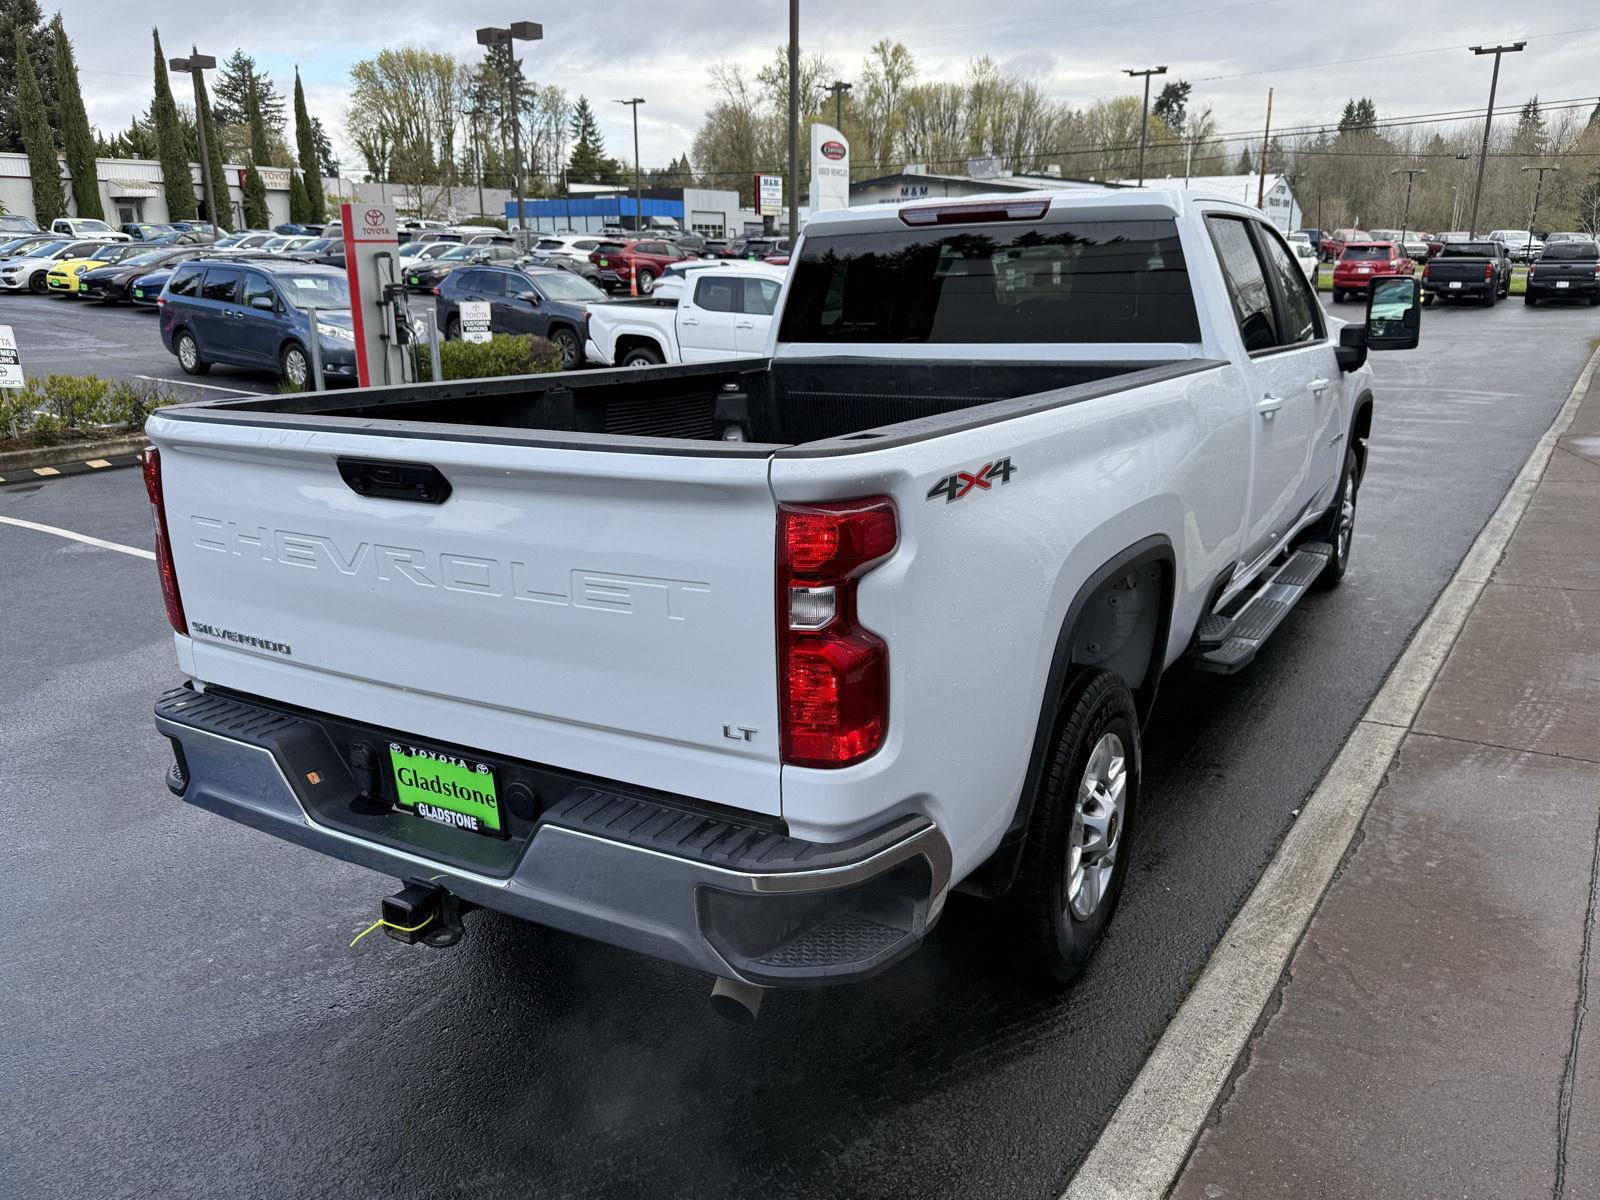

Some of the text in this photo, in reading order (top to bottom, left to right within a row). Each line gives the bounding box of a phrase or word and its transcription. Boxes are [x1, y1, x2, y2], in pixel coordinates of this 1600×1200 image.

[264, 172, 290, 181] TOYOT
[362, 227, 390, 236] TOYOTA
[191, 515, 711, 621] CHEVROLET
[191, 621, 292, 655] SILVERADO
[723, 723, 758, 742] LT
[409, 747, 468, 769] TOYOTA
[397, 767, 497, 809] Gladstone
[418, 803, 479, 831] GLADSTONE
